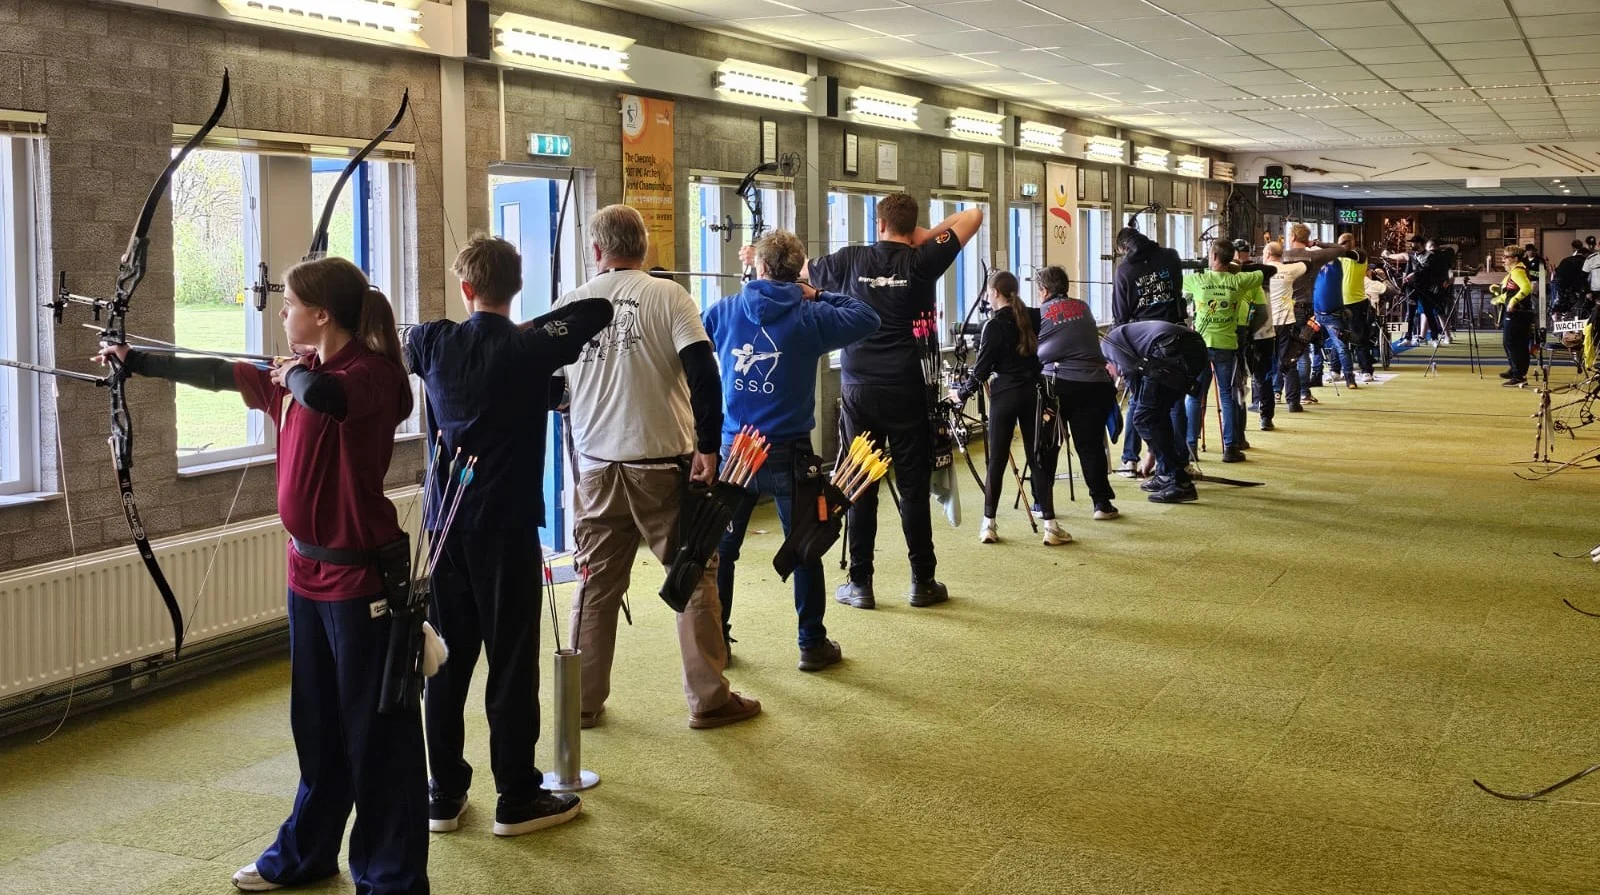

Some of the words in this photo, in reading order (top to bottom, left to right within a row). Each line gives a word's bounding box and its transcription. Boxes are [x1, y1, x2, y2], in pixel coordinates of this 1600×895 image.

[625, 152, 634, 163] The
[644, 168, 661, 179] Archery
[639, 181, 672, 192] Championships
[1262, 178, 1282, 189] 226
